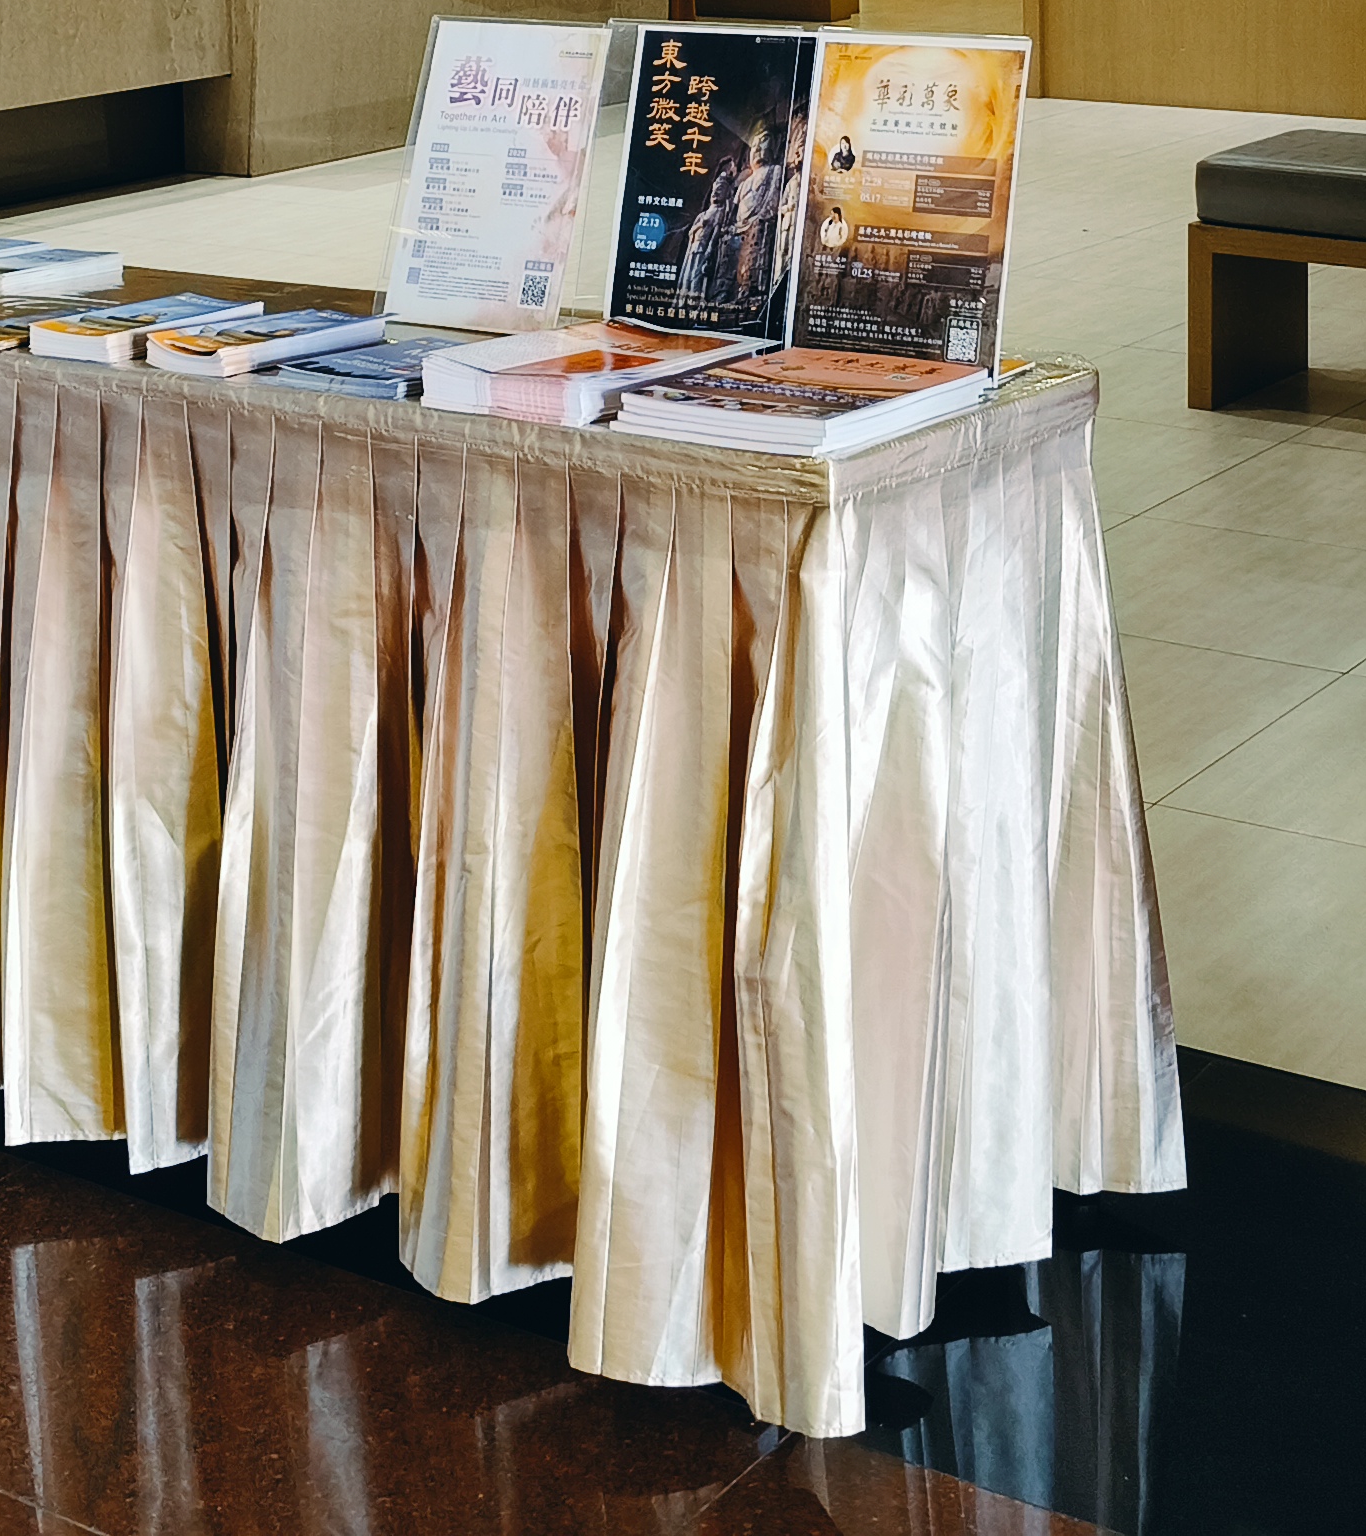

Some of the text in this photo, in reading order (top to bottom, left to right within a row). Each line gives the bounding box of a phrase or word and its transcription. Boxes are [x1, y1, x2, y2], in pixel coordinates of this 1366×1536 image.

[440, 111, 507, 123] Together in Art
[448, 56, 581, 128] 藝同陪伴
[645, 39, 688, 150] 東方微笑
[680, 75, 718, 175] 跨越千年
[639, 217, 660, 227] 12.13
